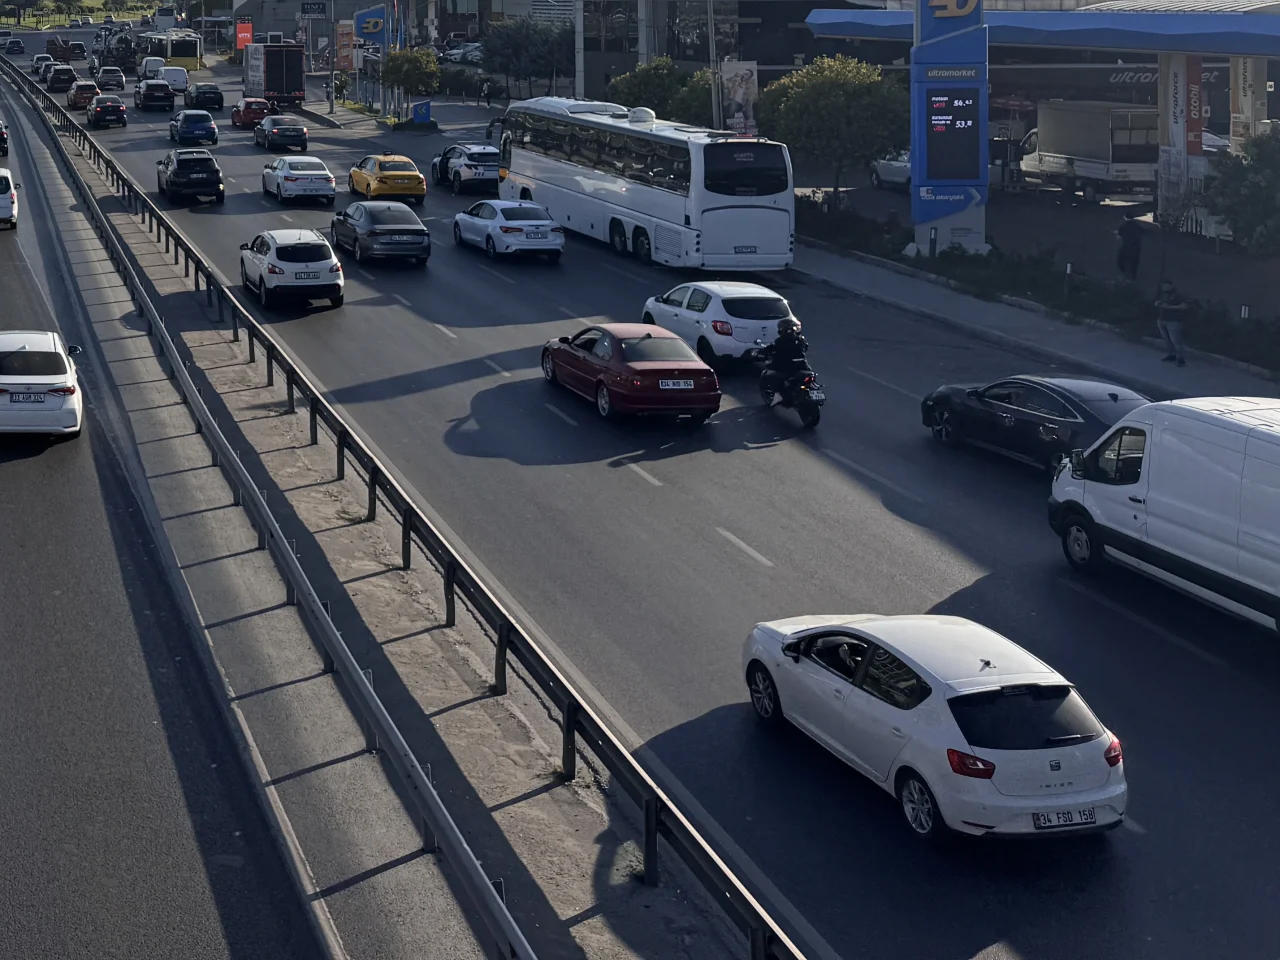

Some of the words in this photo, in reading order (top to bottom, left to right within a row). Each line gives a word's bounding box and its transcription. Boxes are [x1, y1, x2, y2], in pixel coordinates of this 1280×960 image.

[928, 69, 976, 77] ultramarket
[1109, 71, 1219, 83] ultraet
[1189, 84, 1200, 119] otobil
[1040, 812, 1052, 825] 34
[1057, 810, 1073, 823] FSD
[1079, 808, 1094, 821] 158
